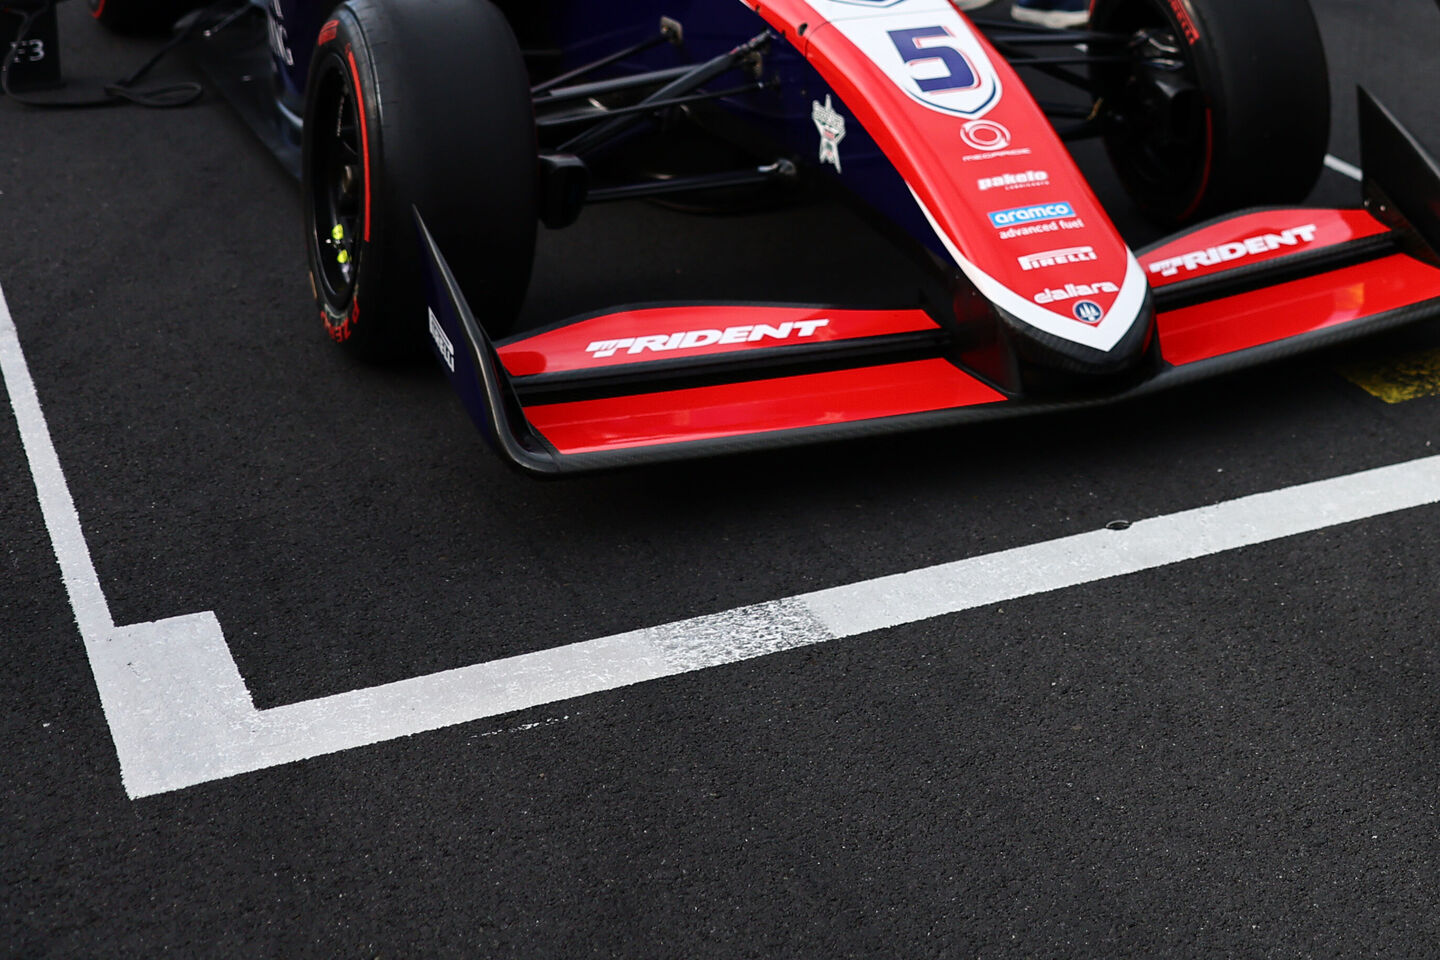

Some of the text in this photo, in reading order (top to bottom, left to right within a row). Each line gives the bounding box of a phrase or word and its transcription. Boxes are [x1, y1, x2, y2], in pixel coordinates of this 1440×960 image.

[886, 25, 982, 95] 5
[977, 170, 1048, 191] pakelo
[994, 204, 1069, 224] aramco
[999, 218, 1085, 240] advanced fuel
[1017, 246, 1098, 271] PIRELLI
[1148, 224, 1317, 277] TRIDENT
[1033, 281, 1120, 304] dallara
[585, 319, 829, 359] TRIDENT
